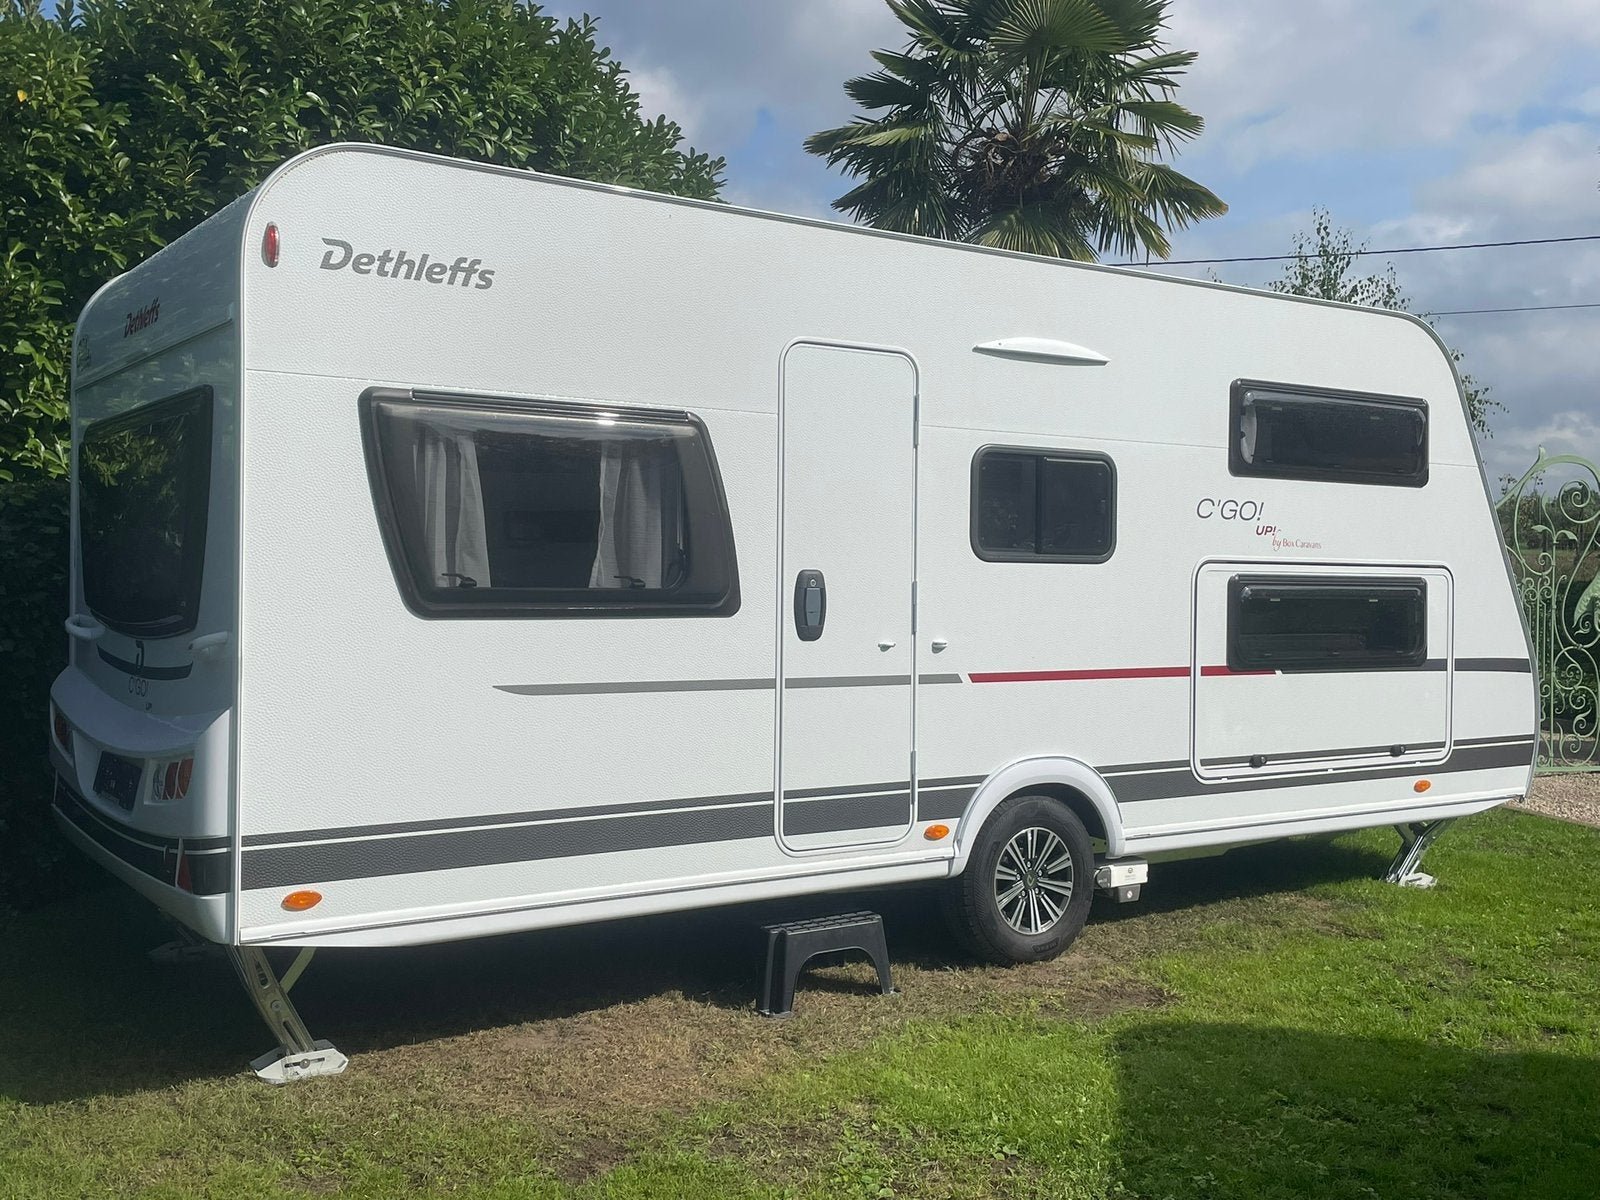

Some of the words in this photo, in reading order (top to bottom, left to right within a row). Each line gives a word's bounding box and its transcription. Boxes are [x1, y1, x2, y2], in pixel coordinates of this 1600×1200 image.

[320, 238, 495, 289] Dethleffs
[124, 297, 159, 337] Dethleffs
[1196, 498, 1264, 521] C'GO!
[1255, 525, 1277, 536] UP!
[1271, 531, 1282, 551] by
[1282, 538, 1295, 548] Box
